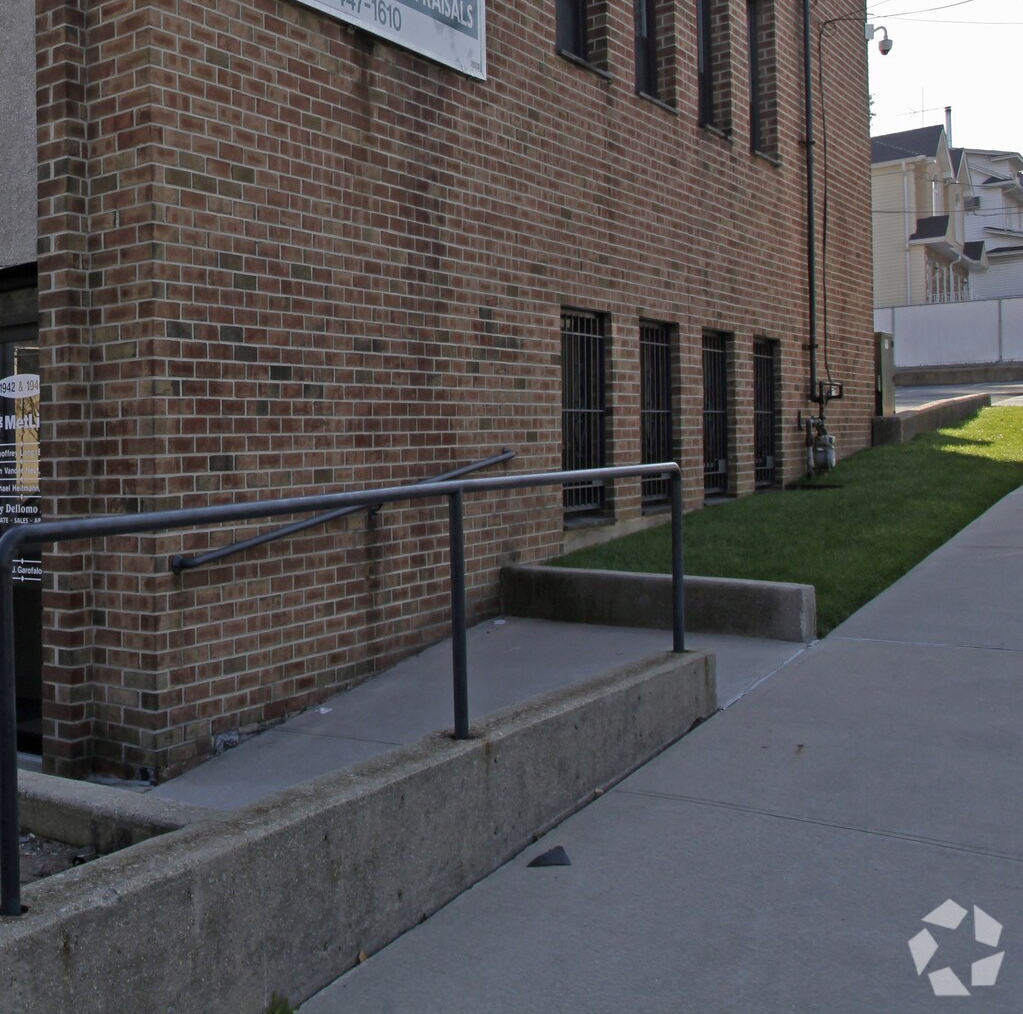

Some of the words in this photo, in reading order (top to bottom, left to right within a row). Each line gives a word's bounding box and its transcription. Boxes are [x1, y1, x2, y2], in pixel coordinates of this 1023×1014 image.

[0, 381, 16, 394] 1942
[18, 381, 24, 392] &
[5, 503, 38, 514] Dellomo
